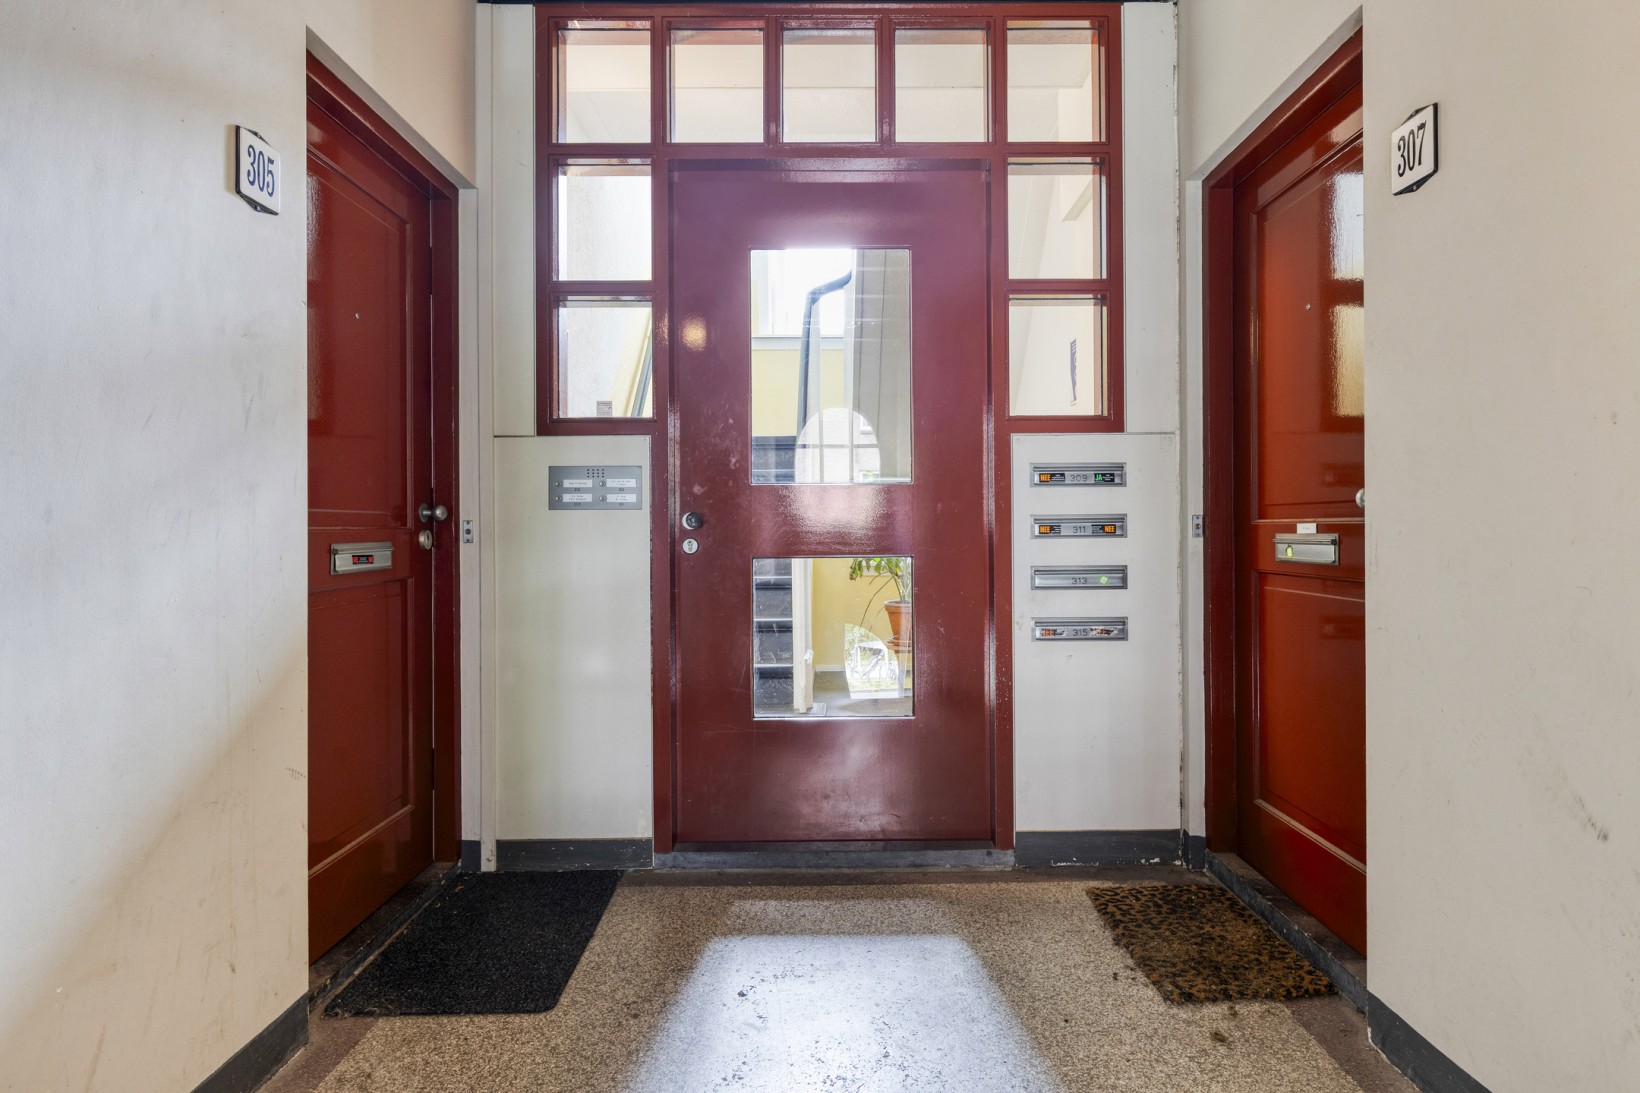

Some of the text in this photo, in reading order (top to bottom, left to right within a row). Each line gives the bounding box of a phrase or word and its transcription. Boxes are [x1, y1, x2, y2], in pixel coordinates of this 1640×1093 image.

[1397, 120, 1427, 177] 307
[247, 144, 275, 197] 305
[1072, 526, 1086, 534] 311
[1072, 577, 1088, 585] 313
[1072, 628, 1088, 636] 315
